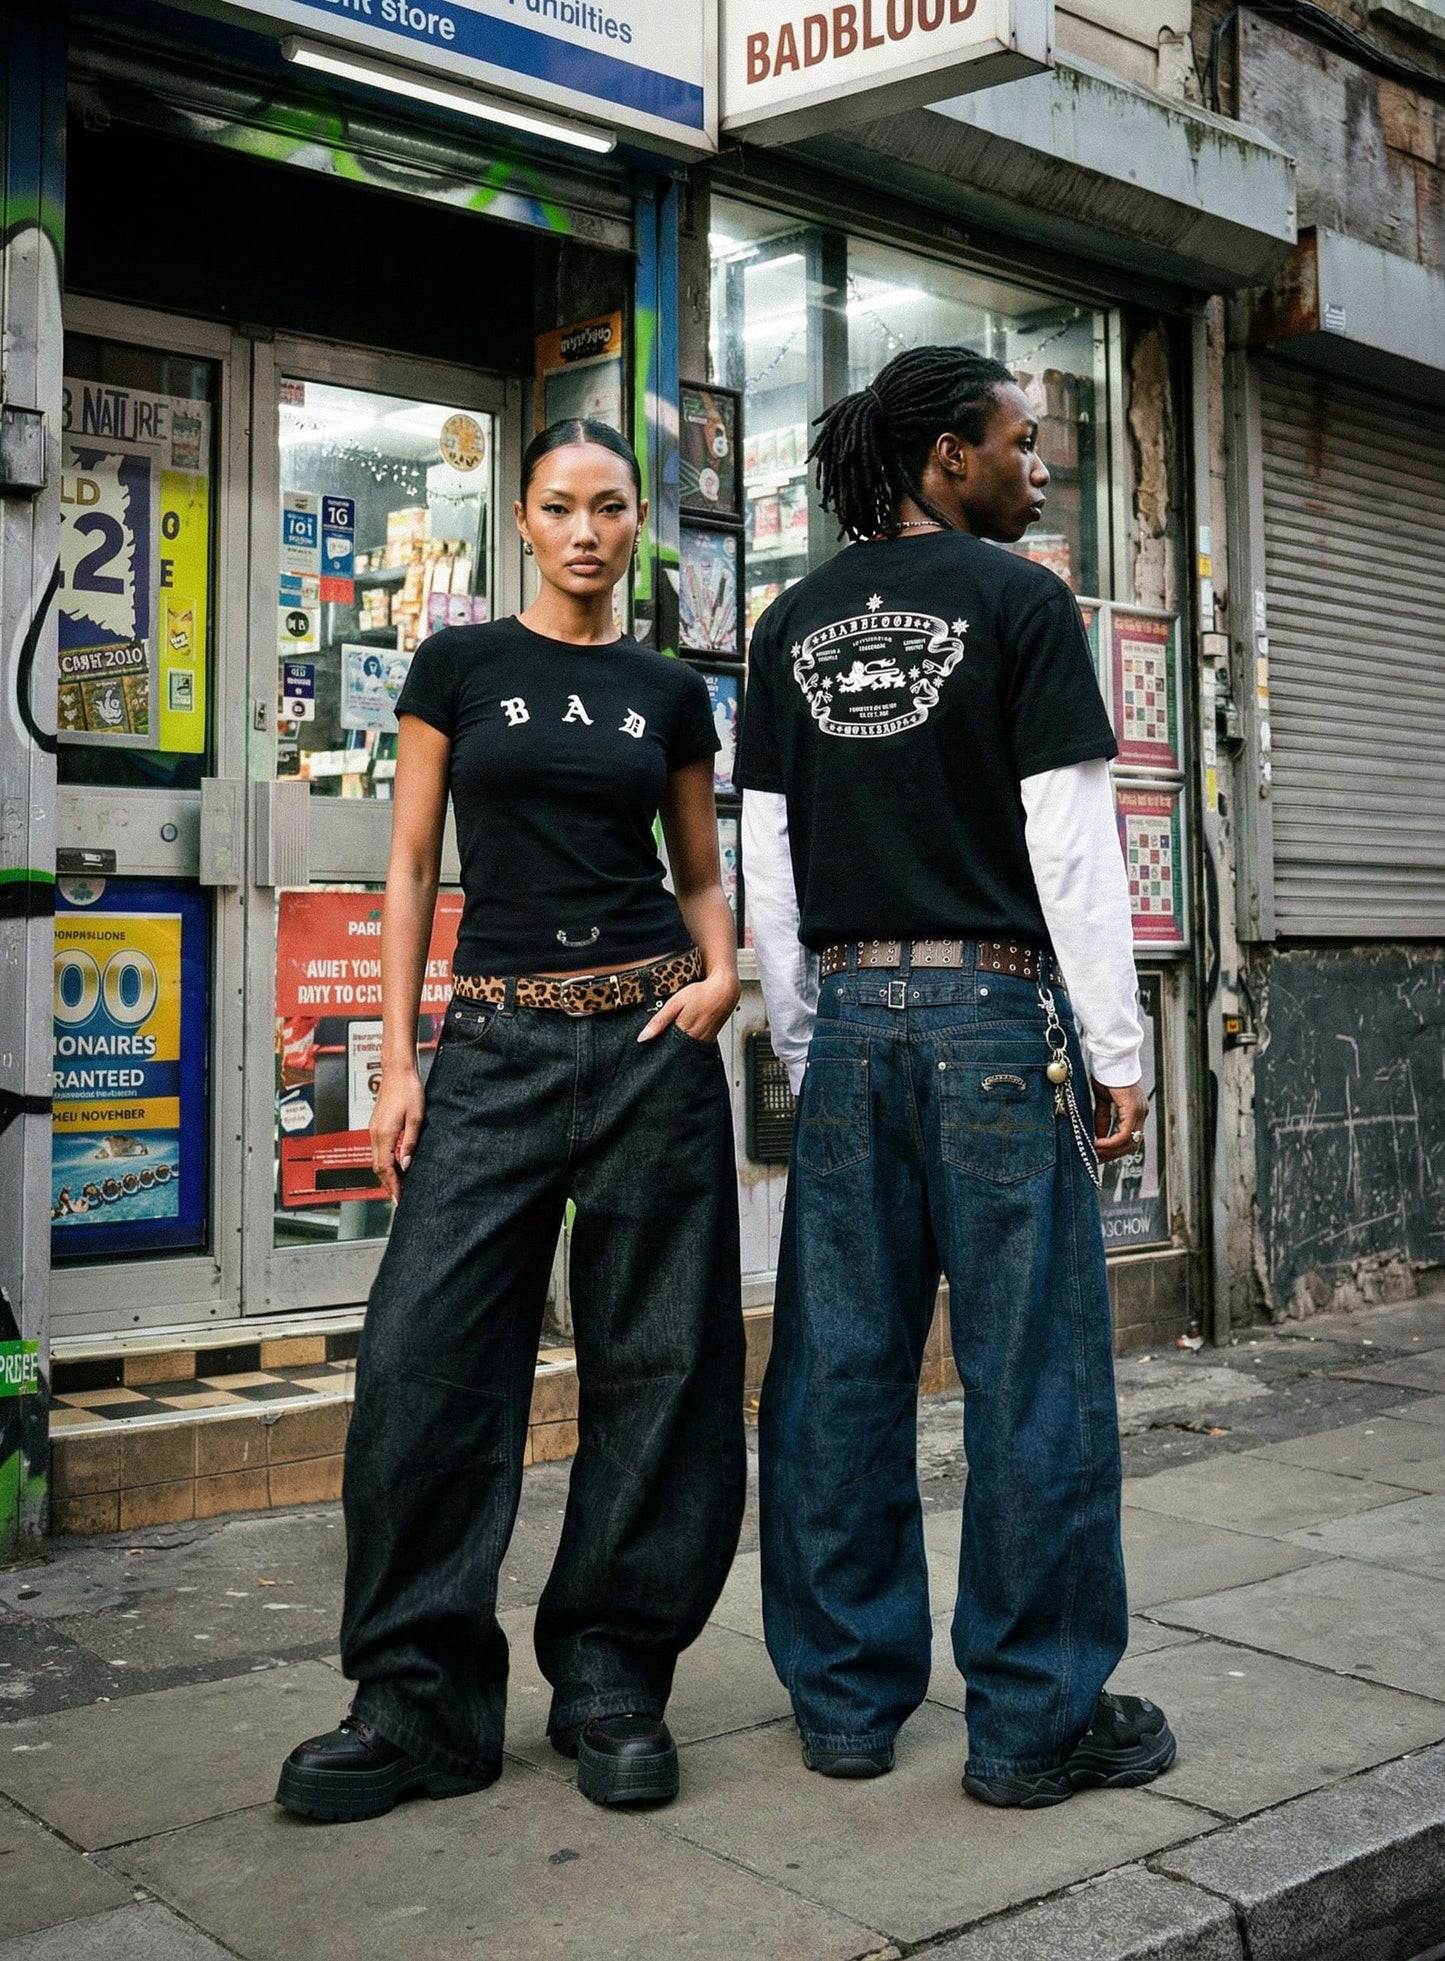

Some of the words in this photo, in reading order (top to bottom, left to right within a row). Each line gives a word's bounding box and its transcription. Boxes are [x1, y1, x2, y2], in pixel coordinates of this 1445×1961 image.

[381, 0, 456, 40] store
[104, 647, 143, 667] 2010
[334, 985, 353, 1004] TO
[54, 1069, 145, 1089] RANTEED
